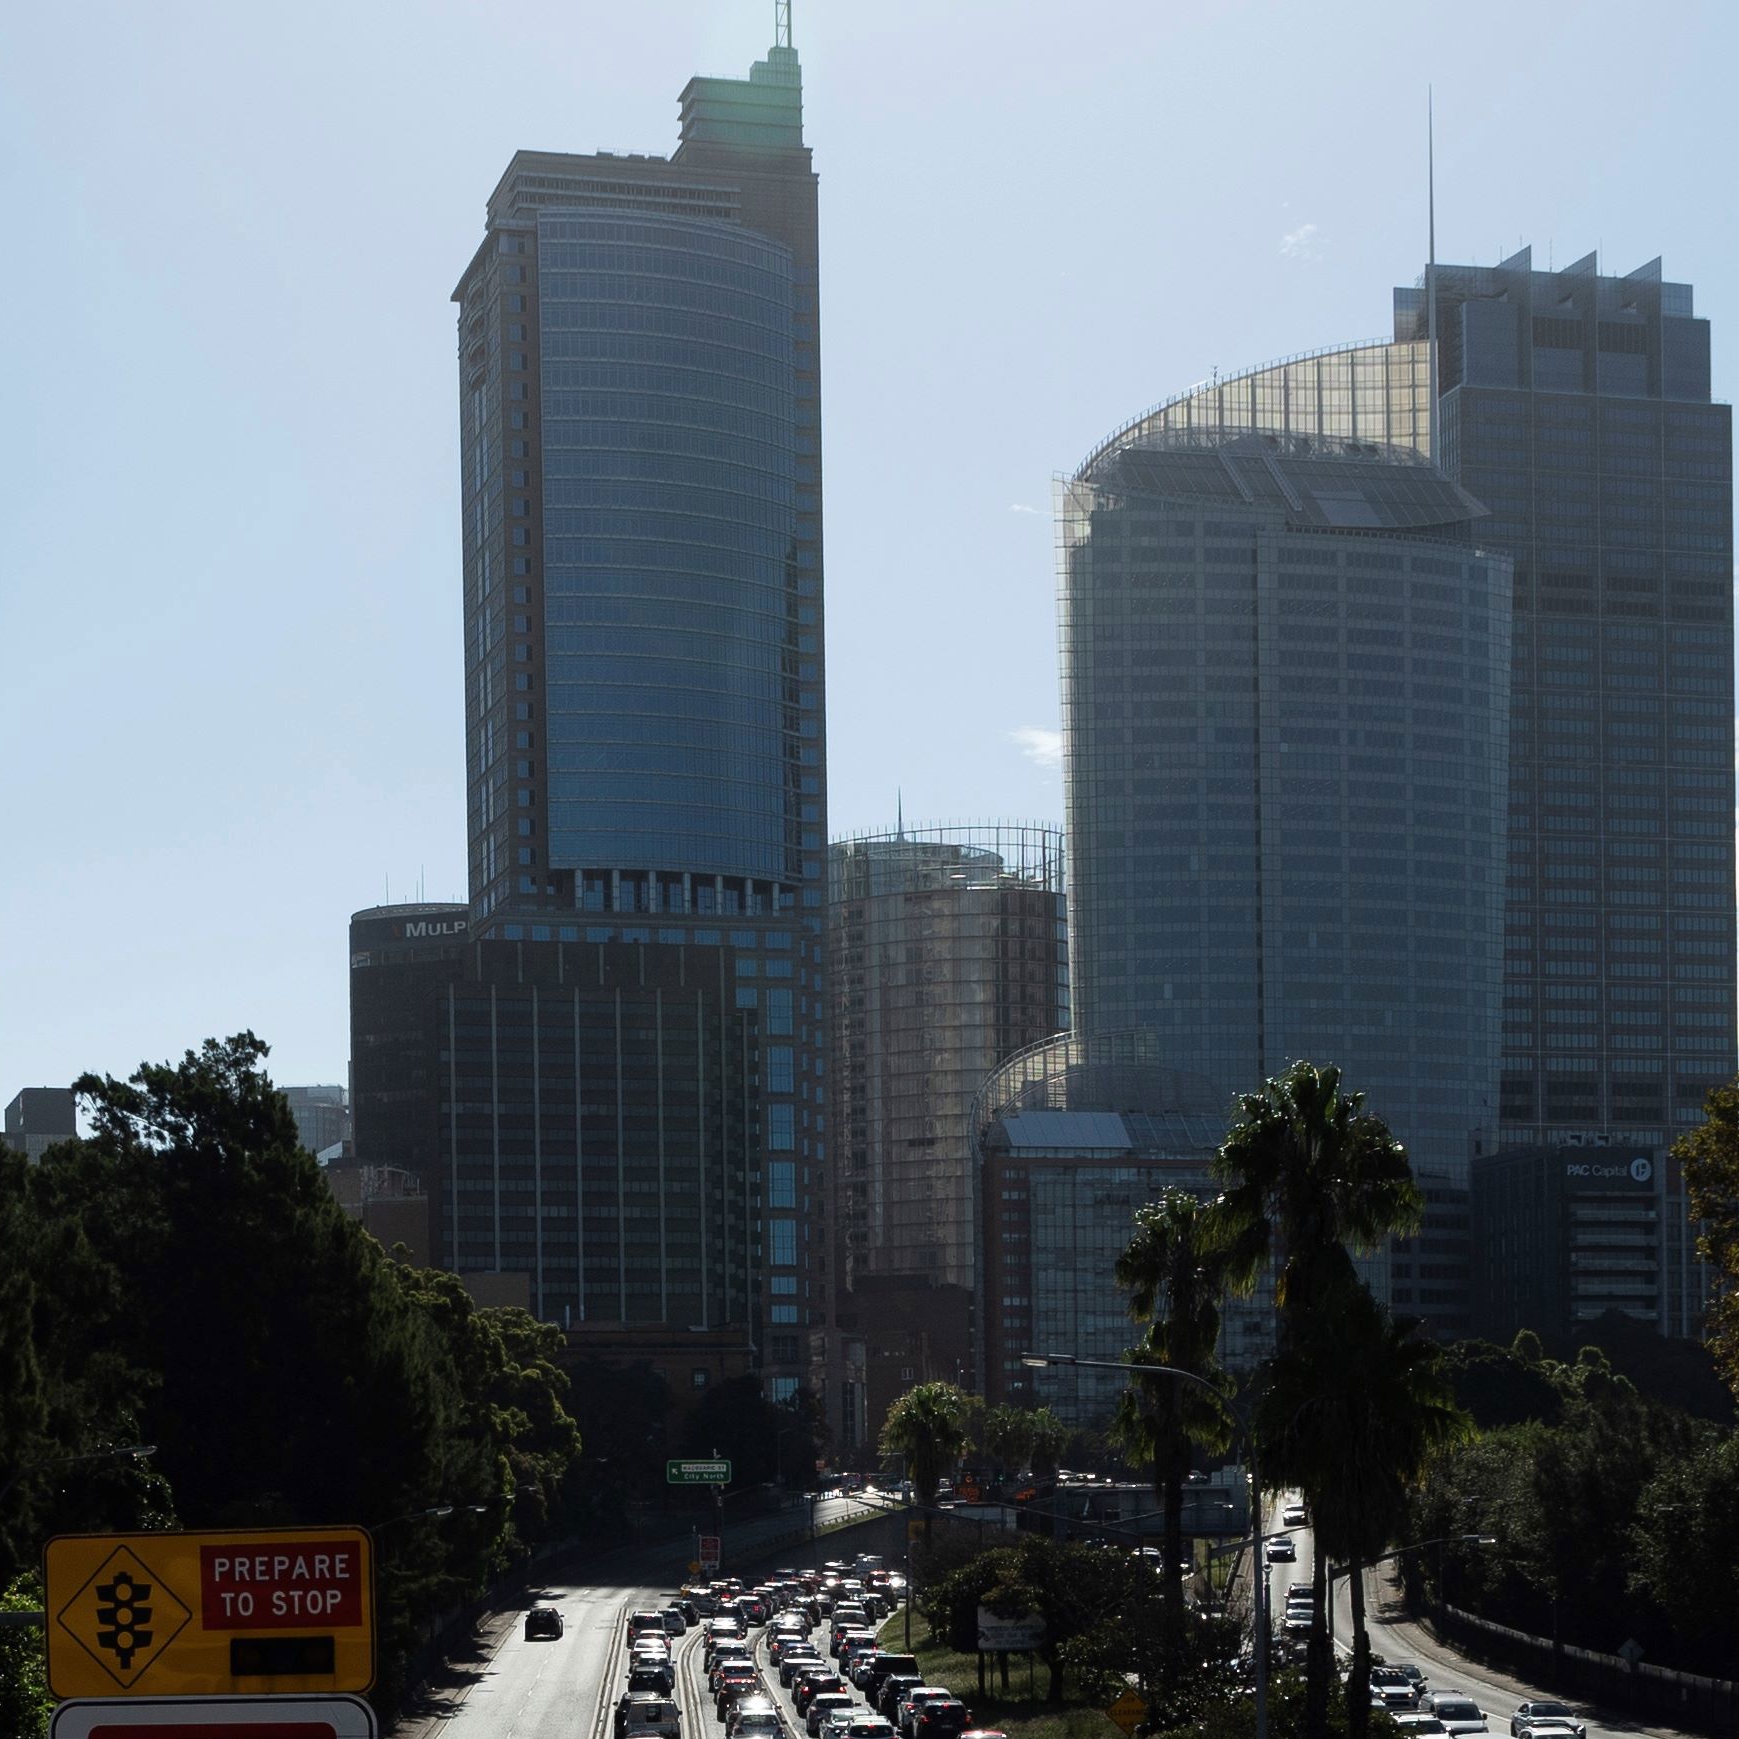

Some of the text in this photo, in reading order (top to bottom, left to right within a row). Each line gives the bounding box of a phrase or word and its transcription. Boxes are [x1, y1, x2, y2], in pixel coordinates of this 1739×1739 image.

[405, 921, 470, 938] MULP
[1566, 1164, 1628, 1179] PAC Capital
[214, 1554, 350, 1582] PREPARE
[221, 1589, 342, 1618] TO STOP
